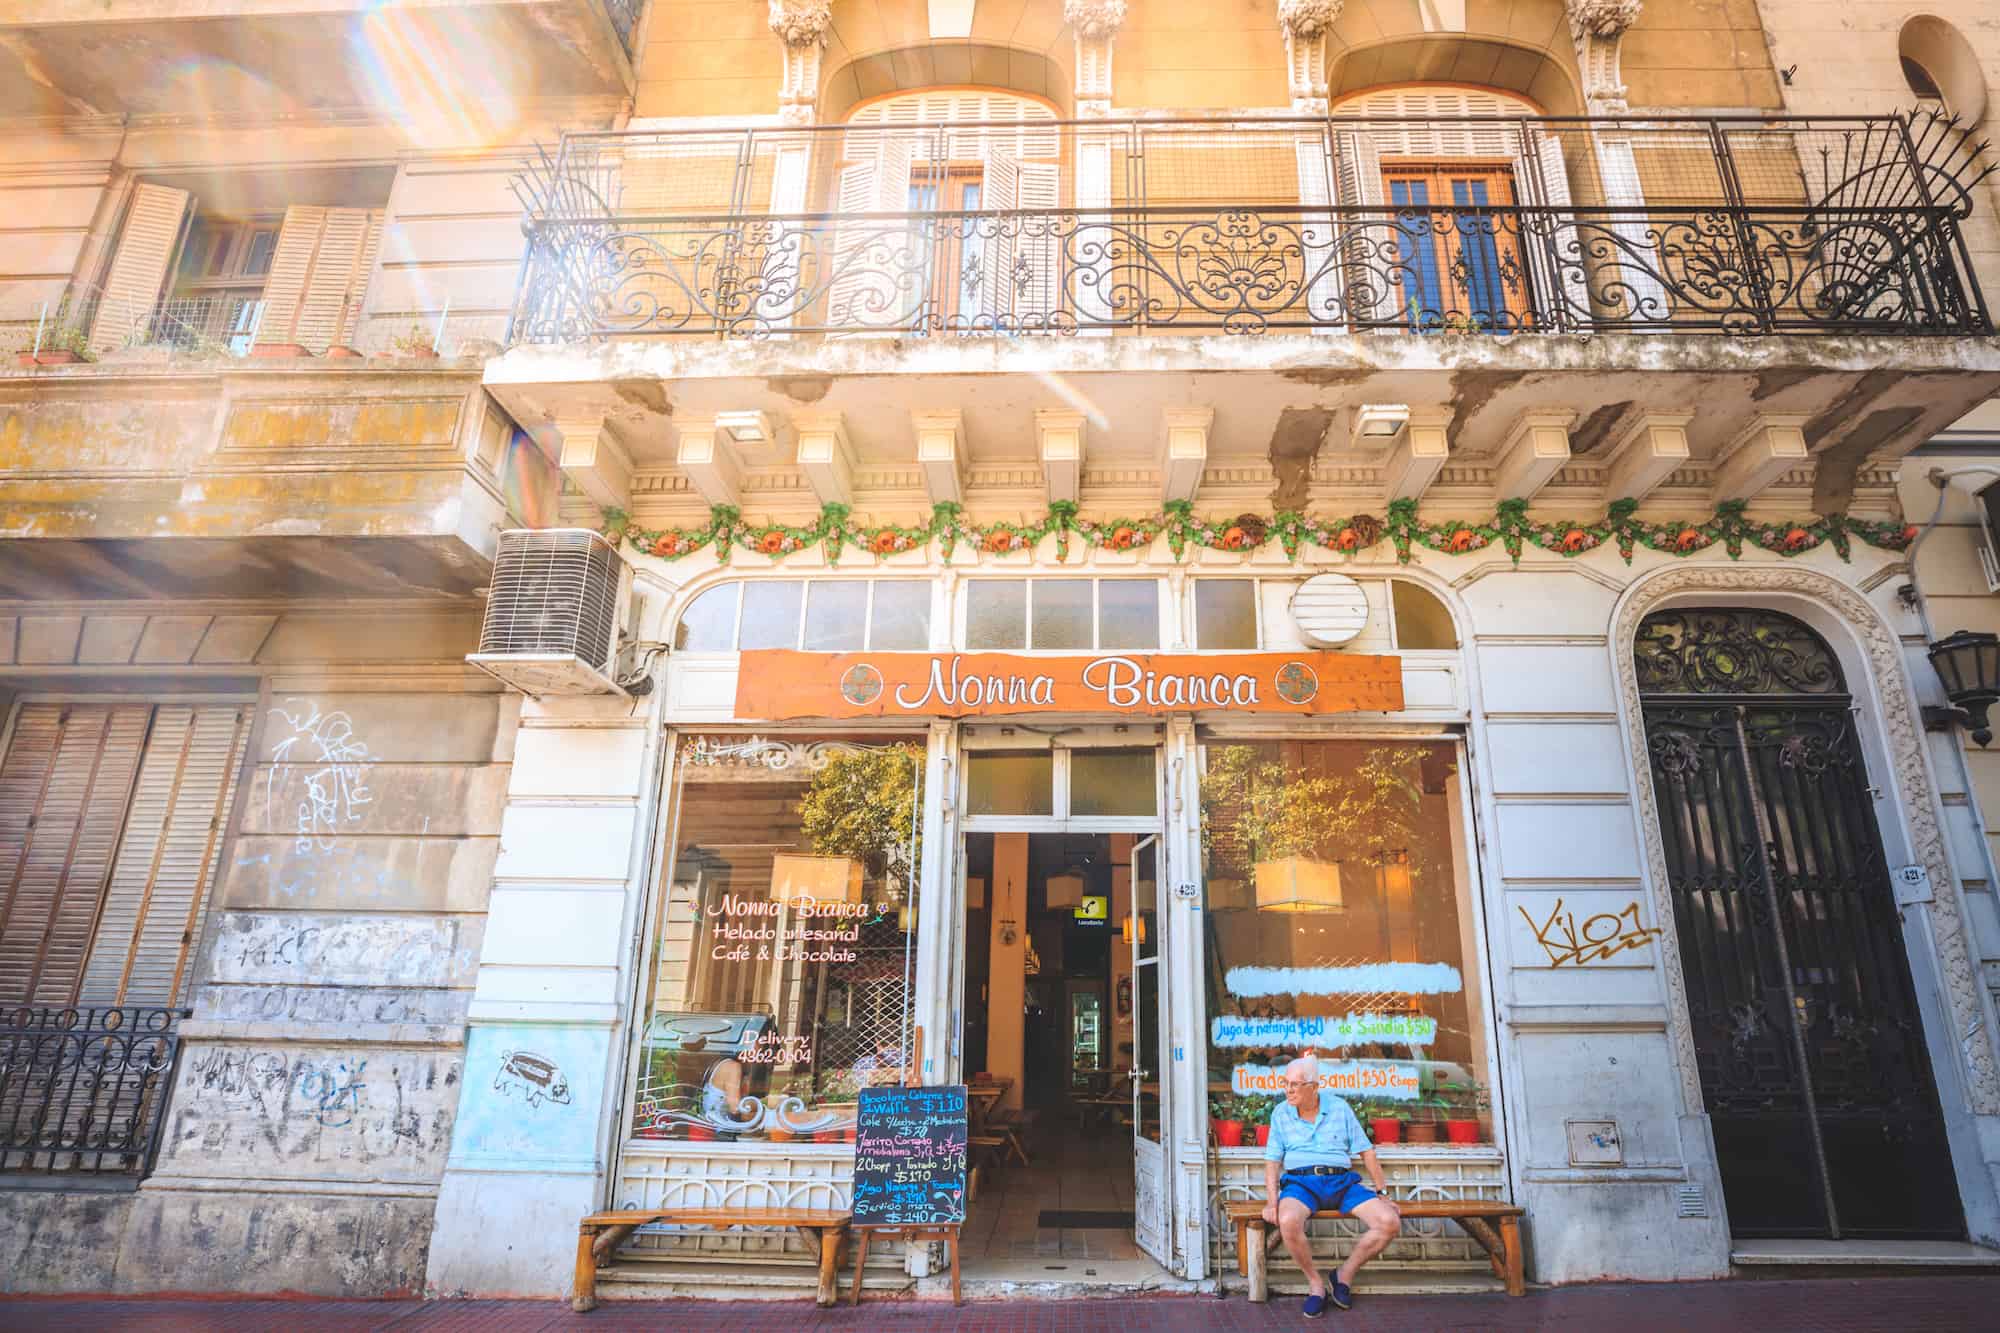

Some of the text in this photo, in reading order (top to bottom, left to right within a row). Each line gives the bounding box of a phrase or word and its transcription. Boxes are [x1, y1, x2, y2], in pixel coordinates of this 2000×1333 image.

[895, 656, 1259, 708] Nonna Bianca
[707, 894, 869, 918] Nonna Bianca
[712, 922, 859, 942] Helado artesanal
[711, 944, 857, 963] Café & Chocolate
[742, 1030, 810, 1048] Delivery
[1216, 1017, 1242, 1041] Jugo
[1257, 1021, 1296, 1040] naranja
[1298, 1016, 1324, 1039] $60
[1318, 1066, 1360, 1089] sanal
[893, 1170, 932, 1183] $170
